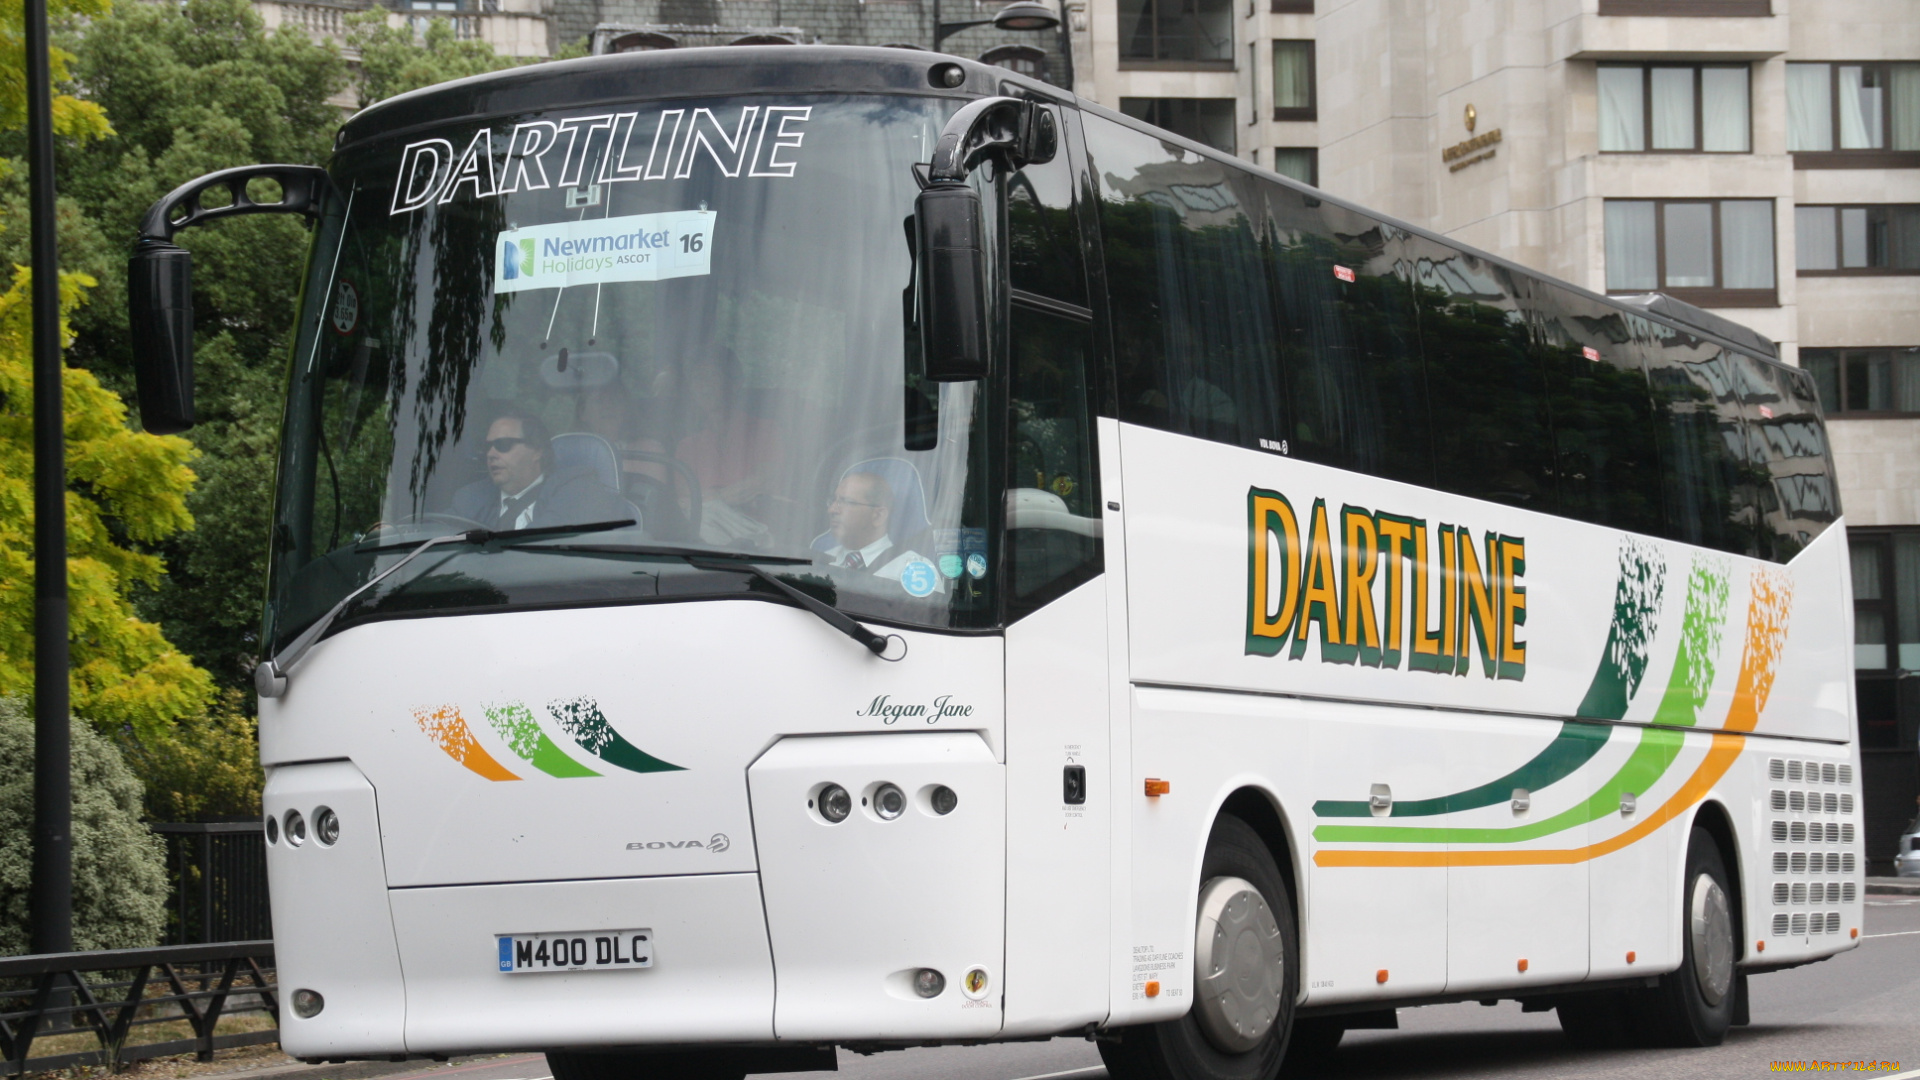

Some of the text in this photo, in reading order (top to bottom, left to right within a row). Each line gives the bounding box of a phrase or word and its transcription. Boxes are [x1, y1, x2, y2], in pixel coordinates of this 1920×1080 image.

[390, 106, 813, 216] DARTLINE
[543, 228, 670, 257] Newmarket
[679, 233, 703, 253] 16
[543, 256, 613, 274] Holidays
[616, 254, 651, 265] ASCOT
[911, 570, 928, 592] 5
[1244, 485, 1527, 682] DARTLINE
[856, 695, 974, 725] Megan Jane
[625, 840, 704, 850] BOVA
[516, 935, 648, 968] M400 DLC
